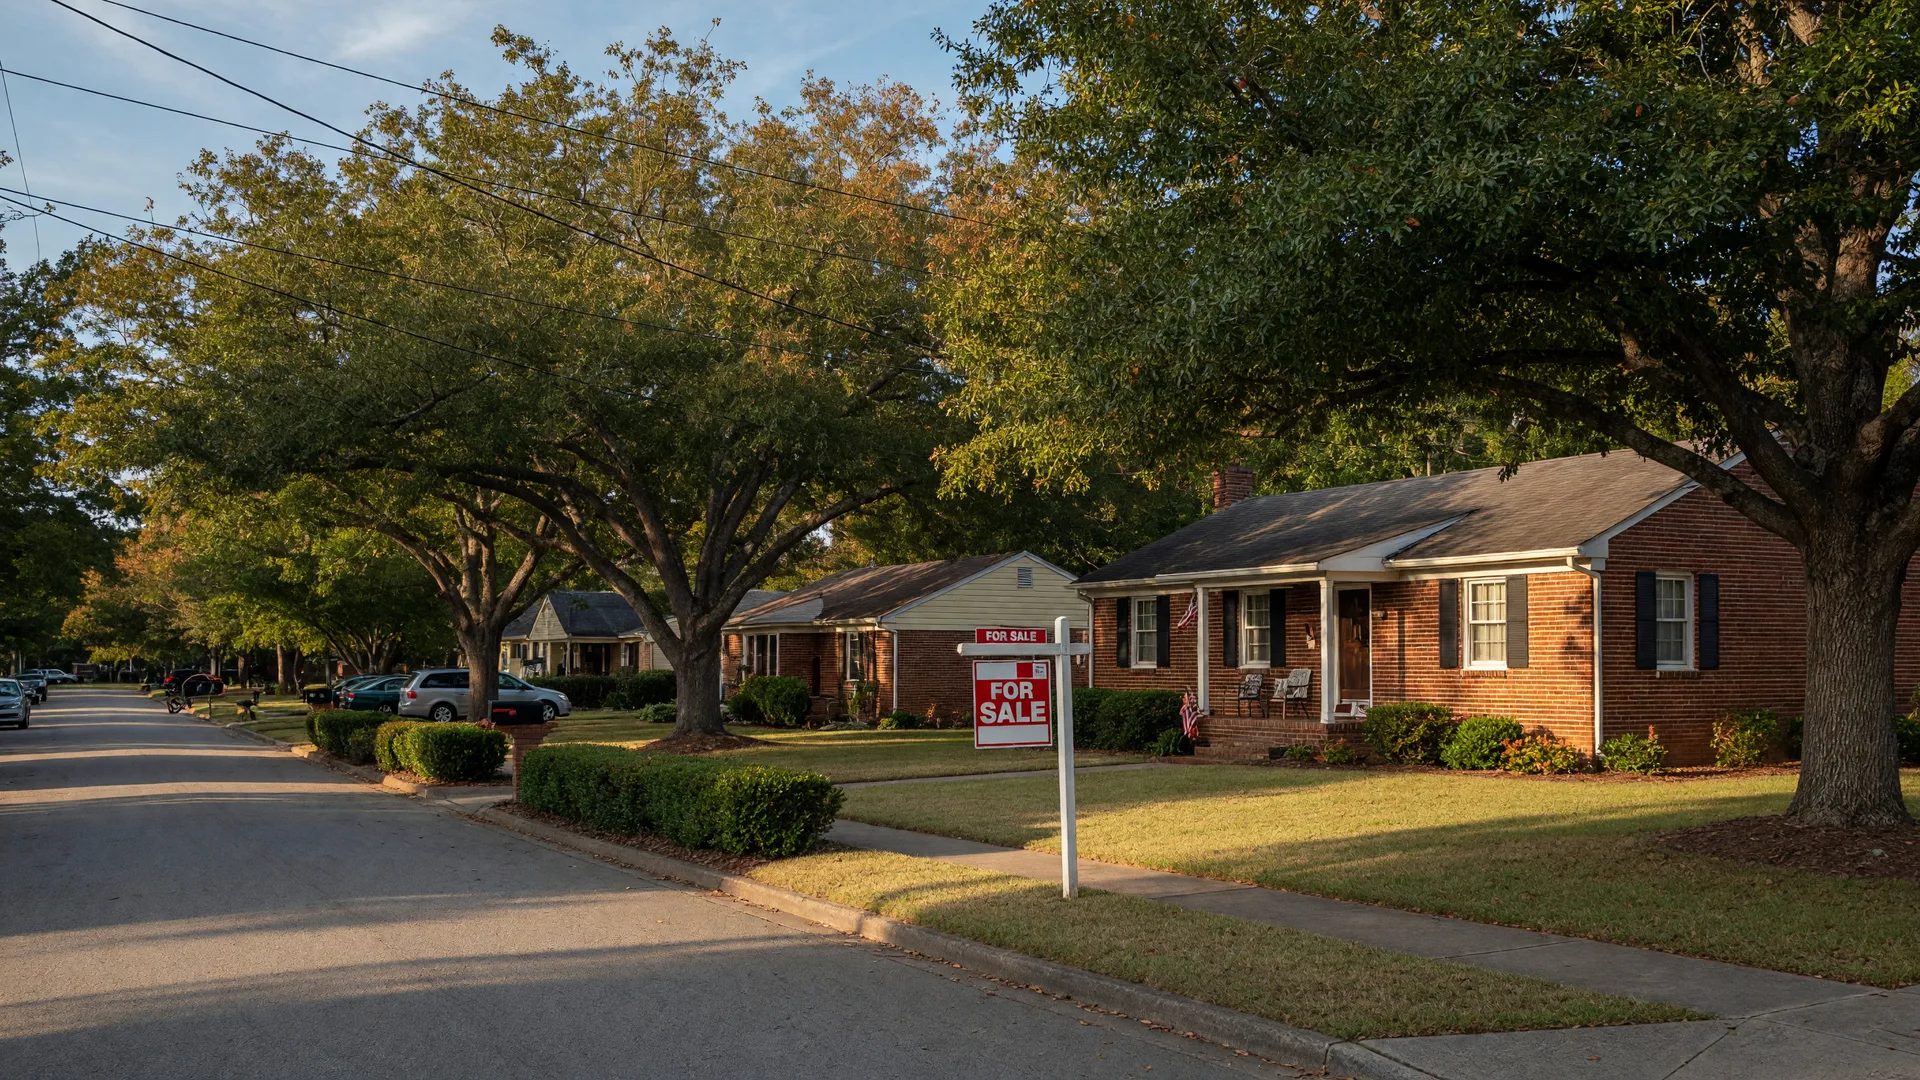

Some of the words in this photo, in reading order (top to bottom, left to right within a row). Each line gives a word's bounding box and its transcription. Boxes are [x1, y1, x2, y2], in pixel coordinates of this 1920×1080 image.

[986, 631, 1007, 641] FOR
[1010, 631, 1036, 641] SALE
[990, 682, 1033, 700] FOR
[980, 701, 1046, 724] SALE
